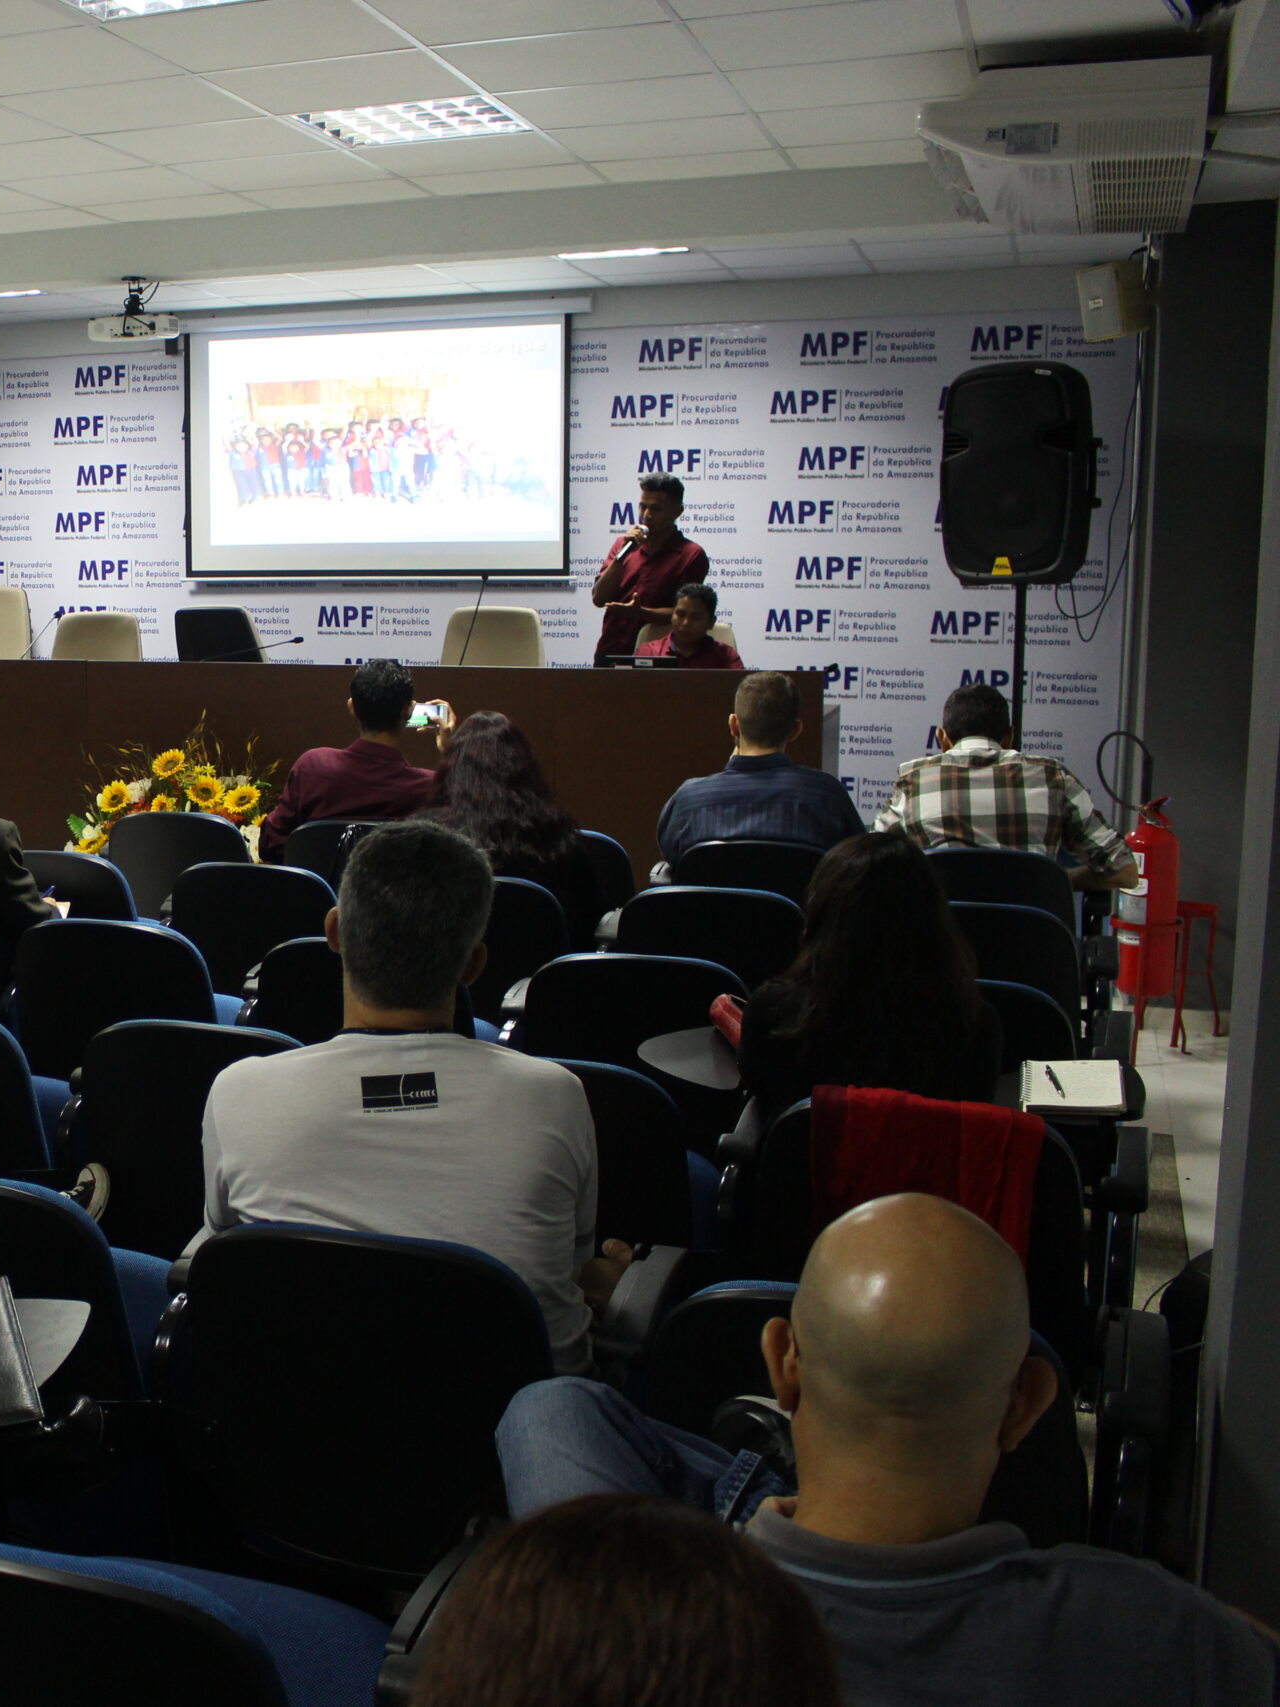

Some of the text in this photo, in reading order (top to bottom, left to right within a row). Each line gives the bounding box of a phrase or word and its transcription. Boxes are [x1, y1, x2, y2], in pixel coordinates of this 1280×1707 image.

[876, 328, 935, 339] Procuradoria
[971, 324, 1043, 352] MPF
[710, 334, 767, 345] Procuradoria
[800, 330, 868, 358] MPF
[639, 337, 703, 364] MPF
[724, 360, 769, 369] Amazonas
[890, 355, 938, 364] Amazonas
[75, 364, 126, 389] MPF
[681, 392, 737, 402] Procuradoria
[845, 387, 904, 398] Procuradoria
[611, 394, 674, 419] MPF
[770, 388, 838, 415] MPF
[695, 417, 740, 425] Amazonas
[859, 413, 906, 422] Amazonas
[54, 415, 104, 439] MPF
[709, 447, 765, 457] Procuradoria
[873, 444, 932, 454] Procuradoria
[638, 449, 701, 474] MPF
[798, 445, 865, 471] MPF
[77, 464, 127, 487] MPF
[722, 472, 767, 481] Amazonas
[887, 470, 935, 479] Amazonas
[842, 499, 900, 509] Procuradoria
[768, 500, 834, 525] MPF
[55, 511, 105, 533] MPF
[855, 525, 902, 533] Amazonas
[870, 556, 929, 566] Procuradoria
[78, 559, 129, 581] MPF
[795, 556, 862, 581] MPF
[883, 581, 931, 590] Amazonas
[380, 606, 430, 614] Procuradoria
[839, 609, 897, 619] Procuradoria
[318, 605, 374, 628] MPF
[765, 609, 831, 633] MPF
[930, 610, 1000, 636] MPF
[392, 628, 432, 637] Amazonas
[853, 634, 899, 643] Amazonas
[866, 667, 924, 677] Procuradoria
[1036, 671, 1098, 682] Procuradoria
[795, 665, 859, 691] PF
[880, 691, 926, 702] Amazonas
[1050, 696, 1100, 707] Amazonas
